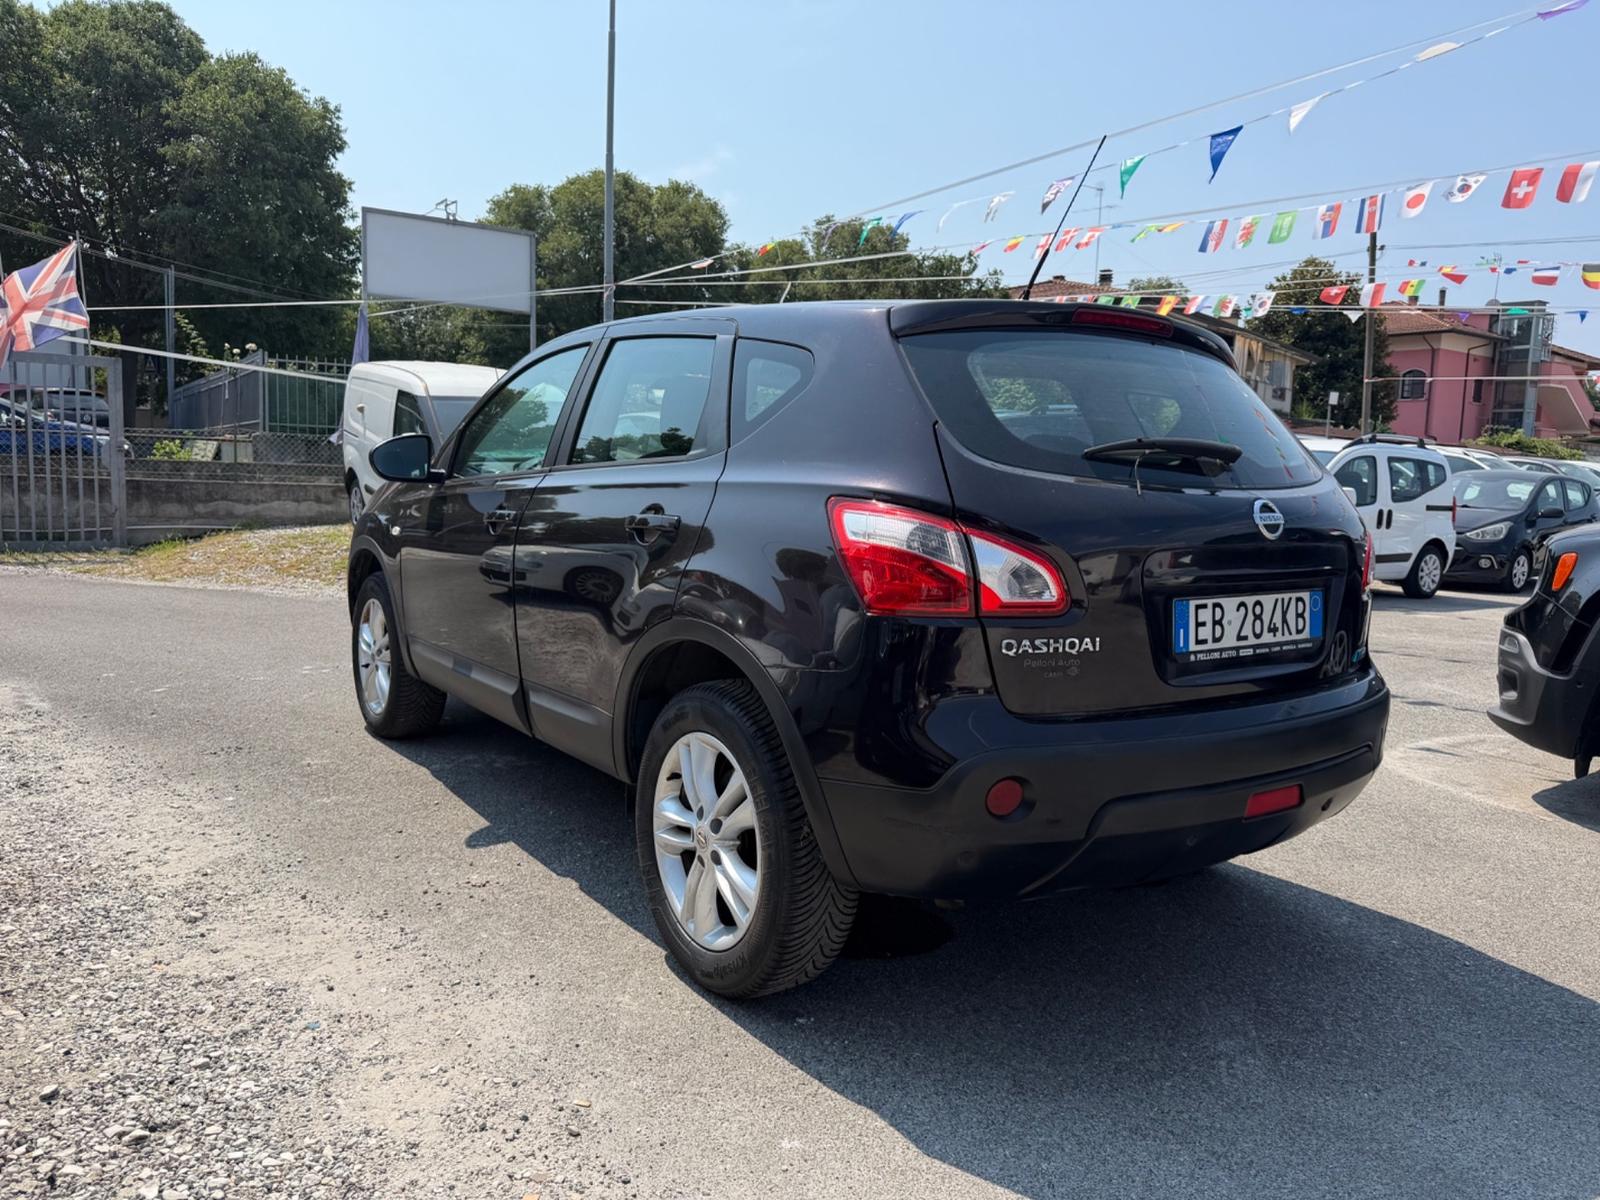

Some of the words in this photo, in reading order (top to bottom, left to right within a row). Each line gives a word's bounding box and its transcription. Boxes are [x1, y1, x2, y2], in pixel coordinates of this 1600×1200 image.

[1195, 602, 1225, 645] EB
[1236, 596, 1306, 642] 284KB
[1001, 637, 1100, 656] QASHQAI
[1222, 649, 1236, 658] AUTO
